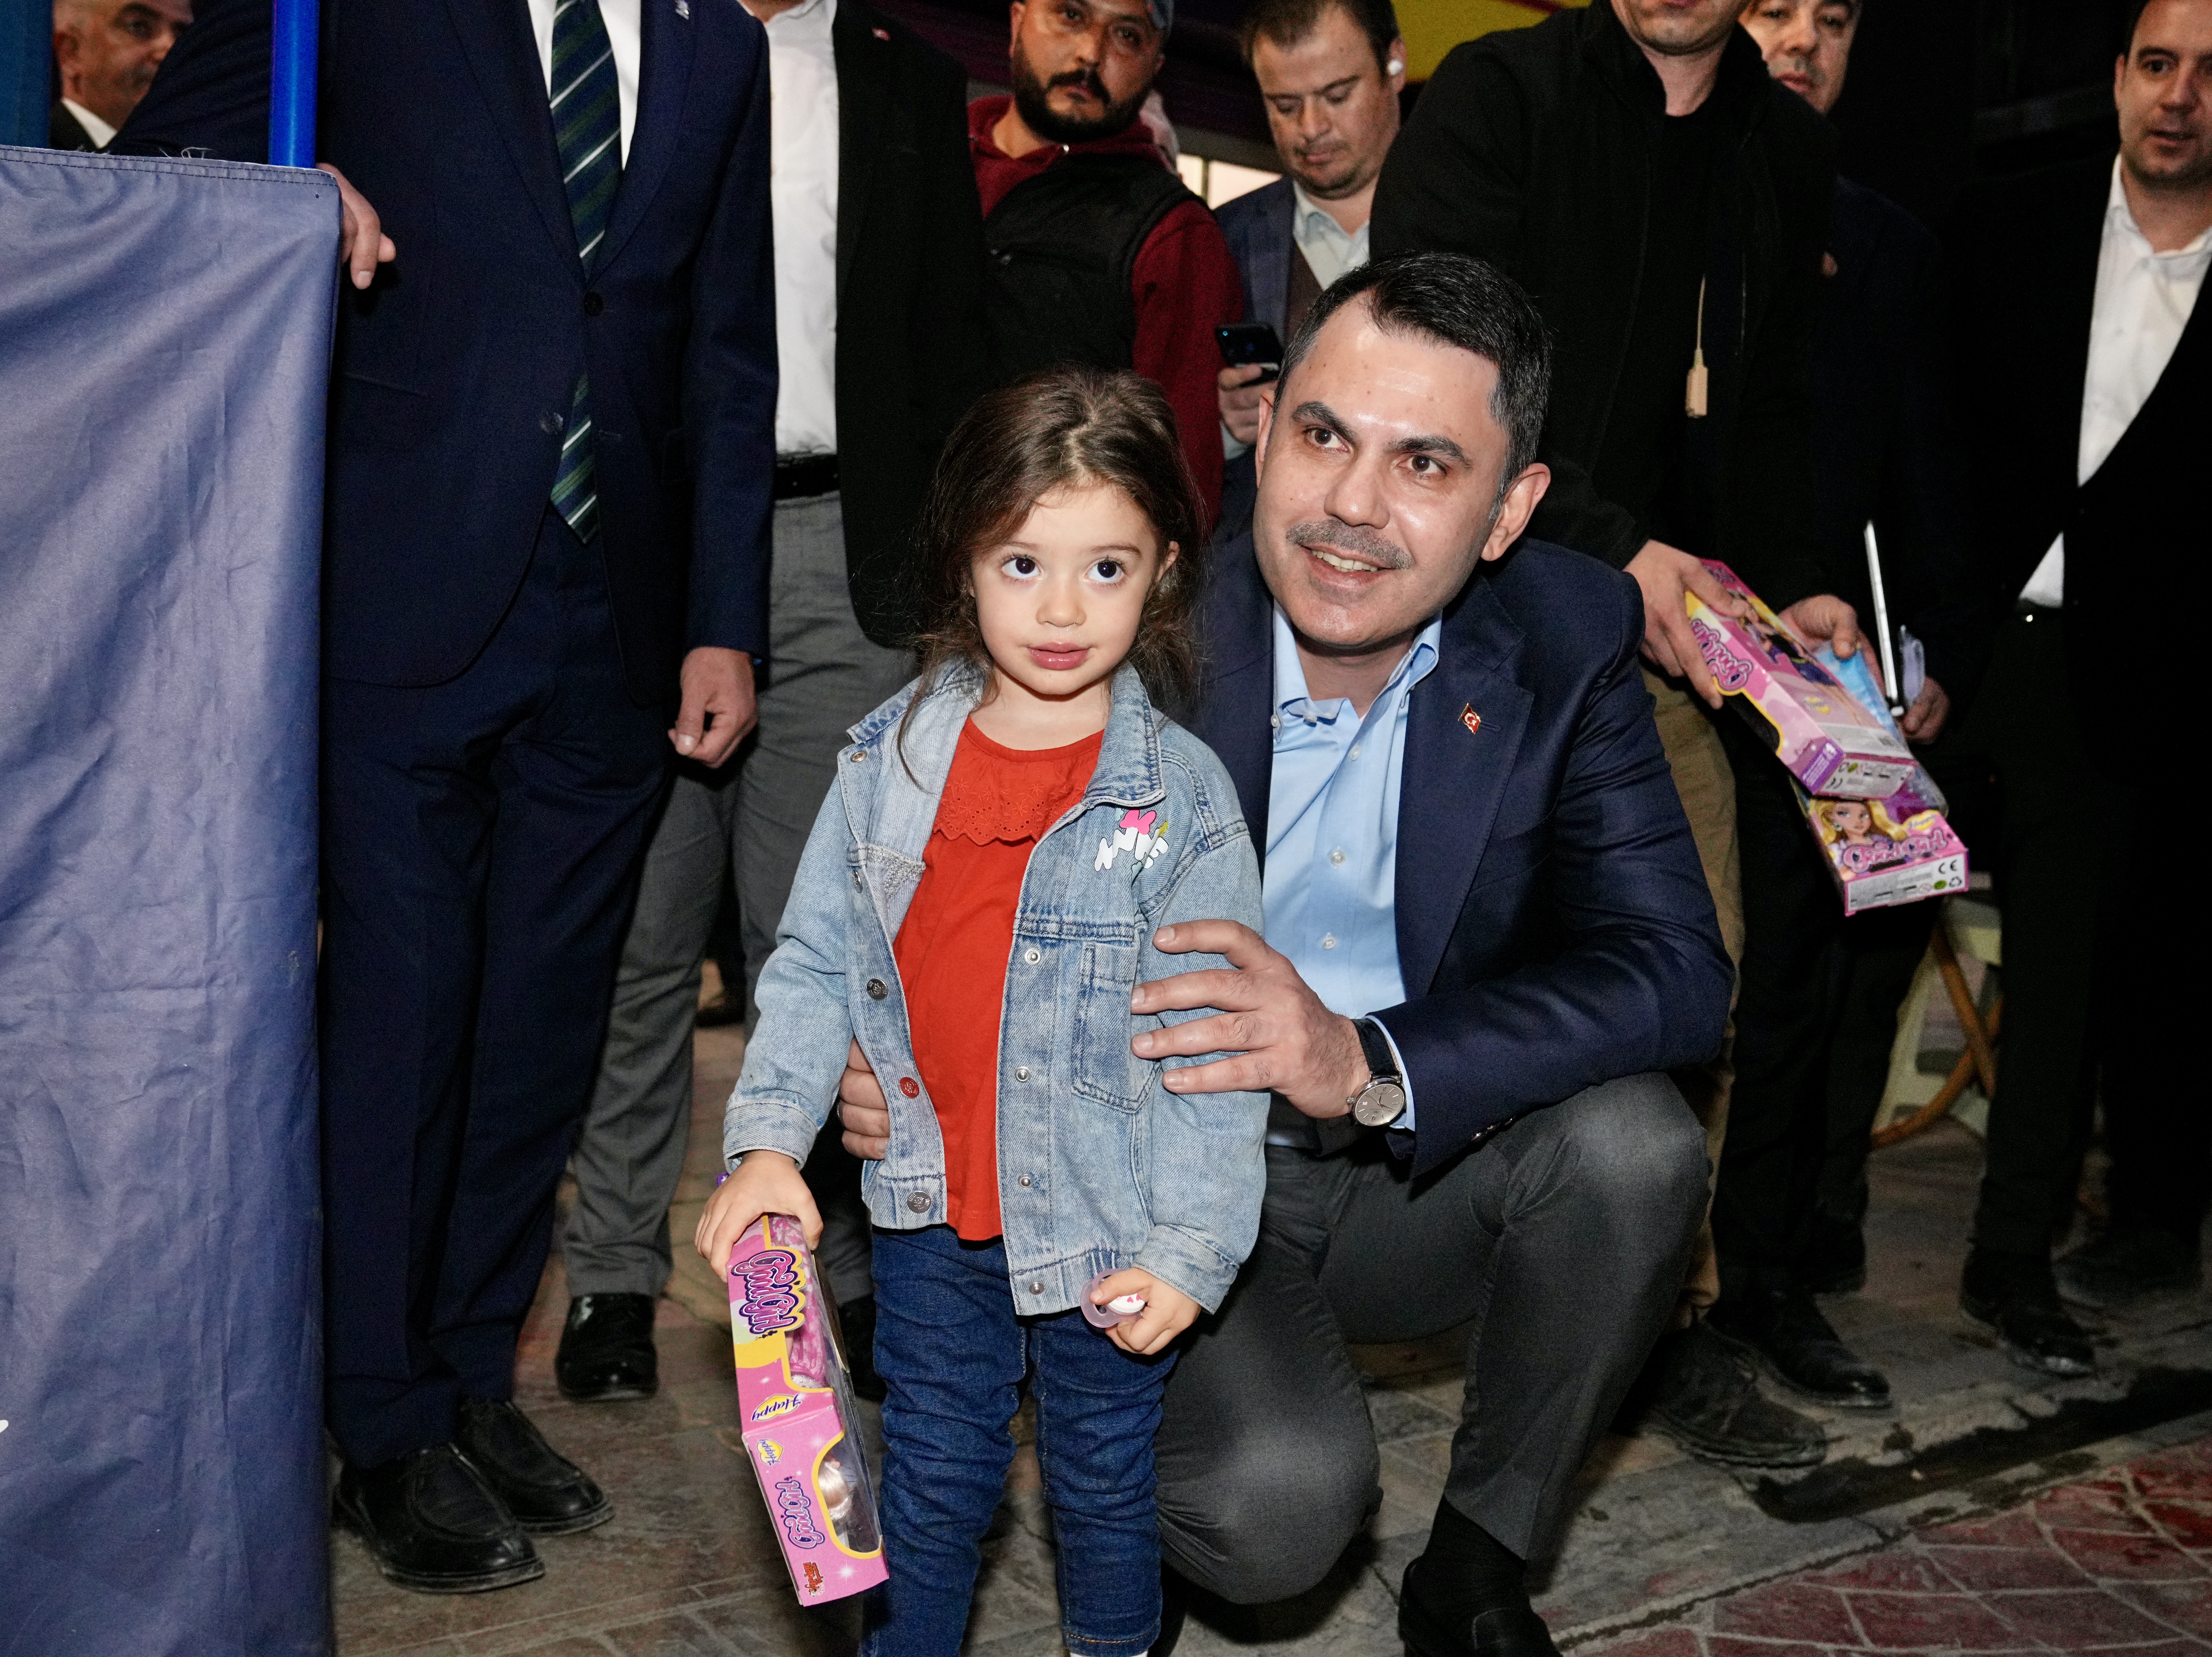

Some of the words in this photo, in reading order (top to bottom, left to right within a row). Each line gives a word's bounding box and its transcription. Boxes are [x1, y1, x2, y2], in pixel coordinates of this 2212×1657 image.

[733, 1250, 796, 1300] Good
[741, 1293, 796, 1332] Girl
[752, 1394, 801, 1421] Happy
[759, 1439, 780, 1465] Happy
[776, 1481, 810, 1510] Girl
[784, 1508, 824, 1548] Good
